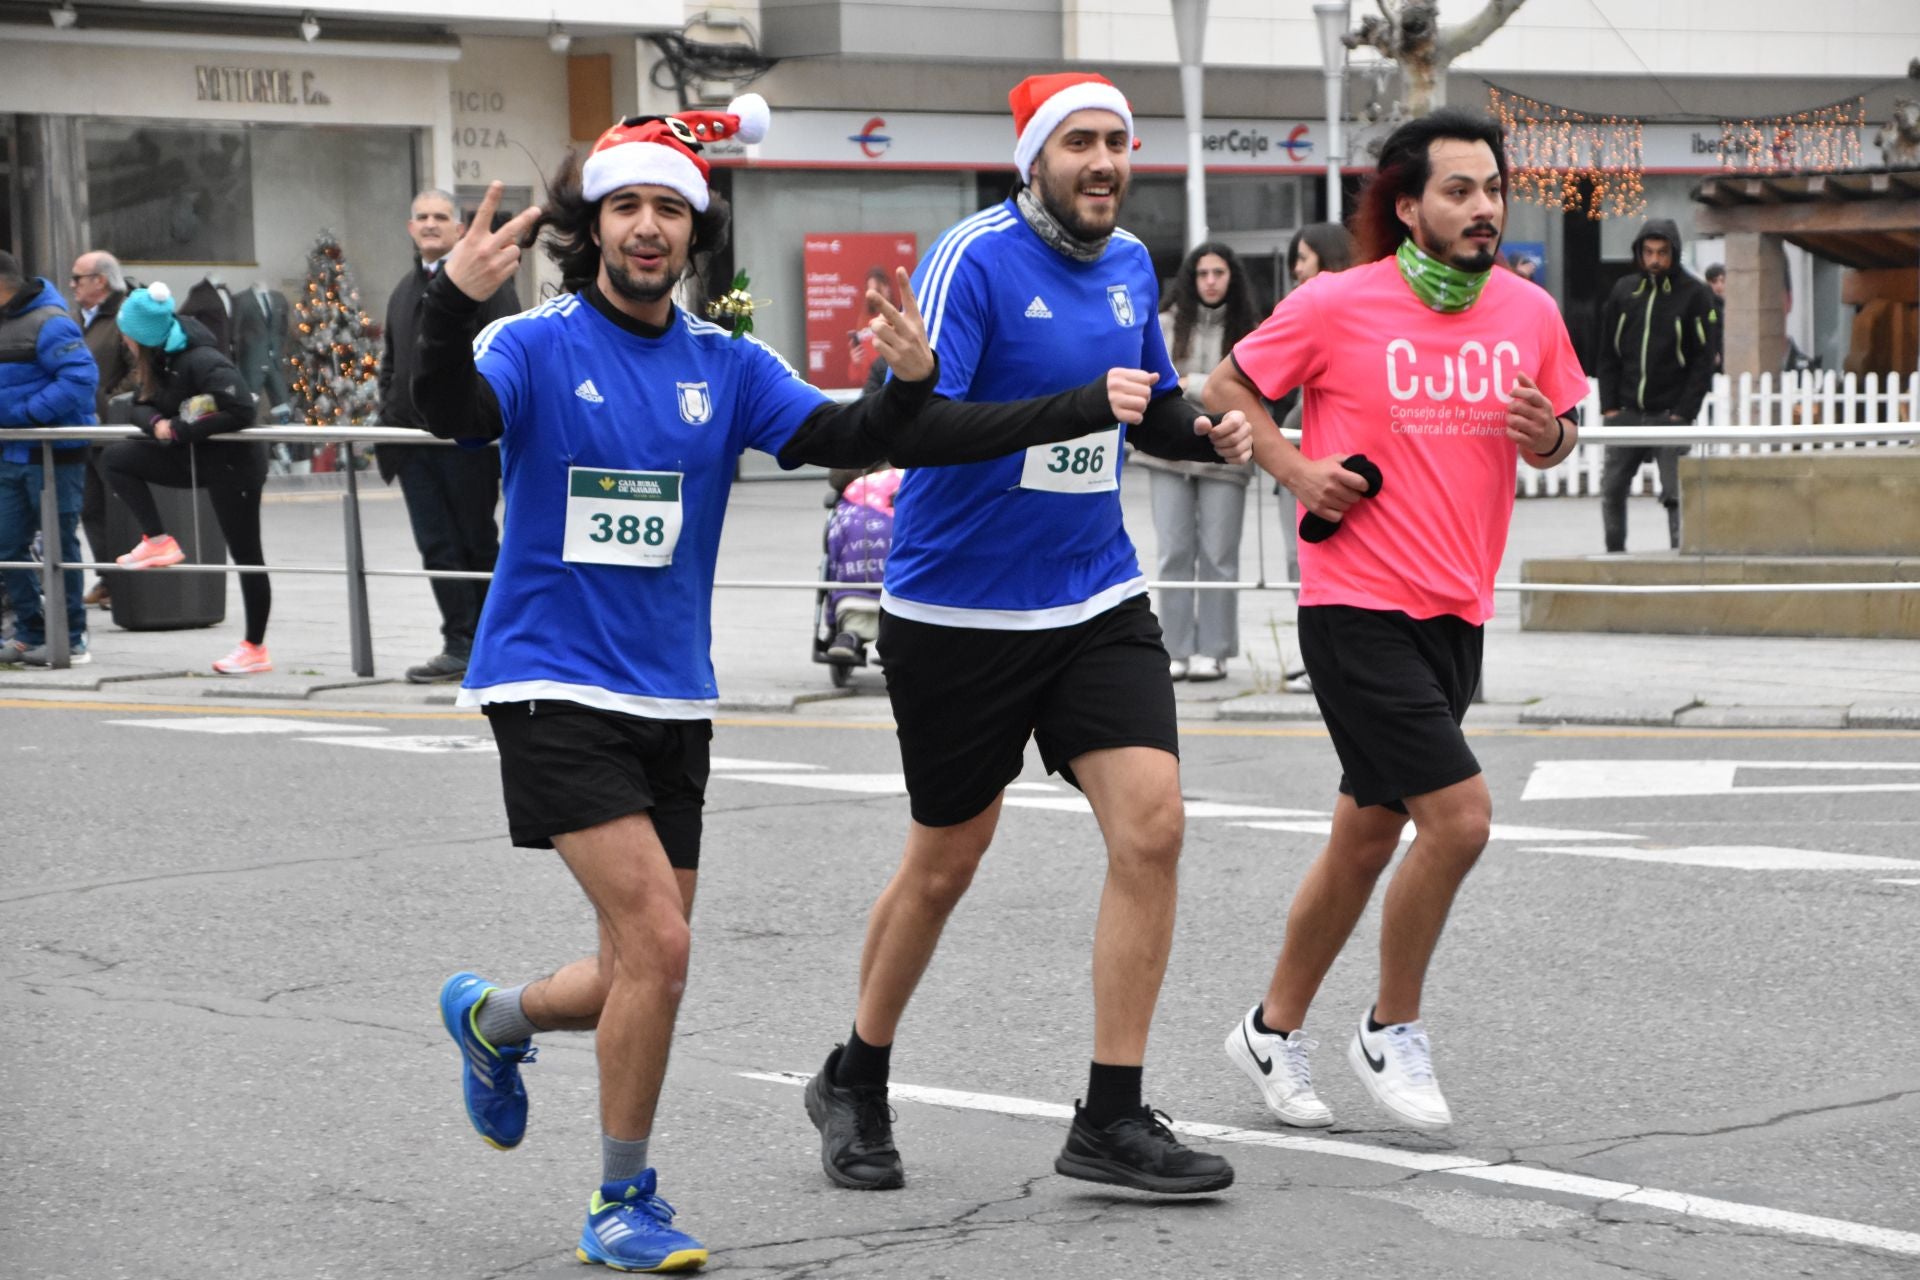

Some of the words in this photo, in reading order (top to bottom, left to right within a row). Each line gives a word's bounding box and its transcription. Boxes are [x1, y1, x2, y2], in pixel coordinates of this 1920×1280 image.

[1202, 129, 1268, 158] erCaja
[1390, 405, 1436, 421] Consejo
[1437, 405, 1452, 418] de
[1455, 406, 1466, 418] la
[1391, 421, 1443, 436] Comarcal
[1445, 422, 1459, 435] de
[1047, 445, 1104, 475] 386
[630, 486, 662, 495] NAVARRA
[636, 480, 660, 489] RURAL
[589, 513, 665, 546] 388
